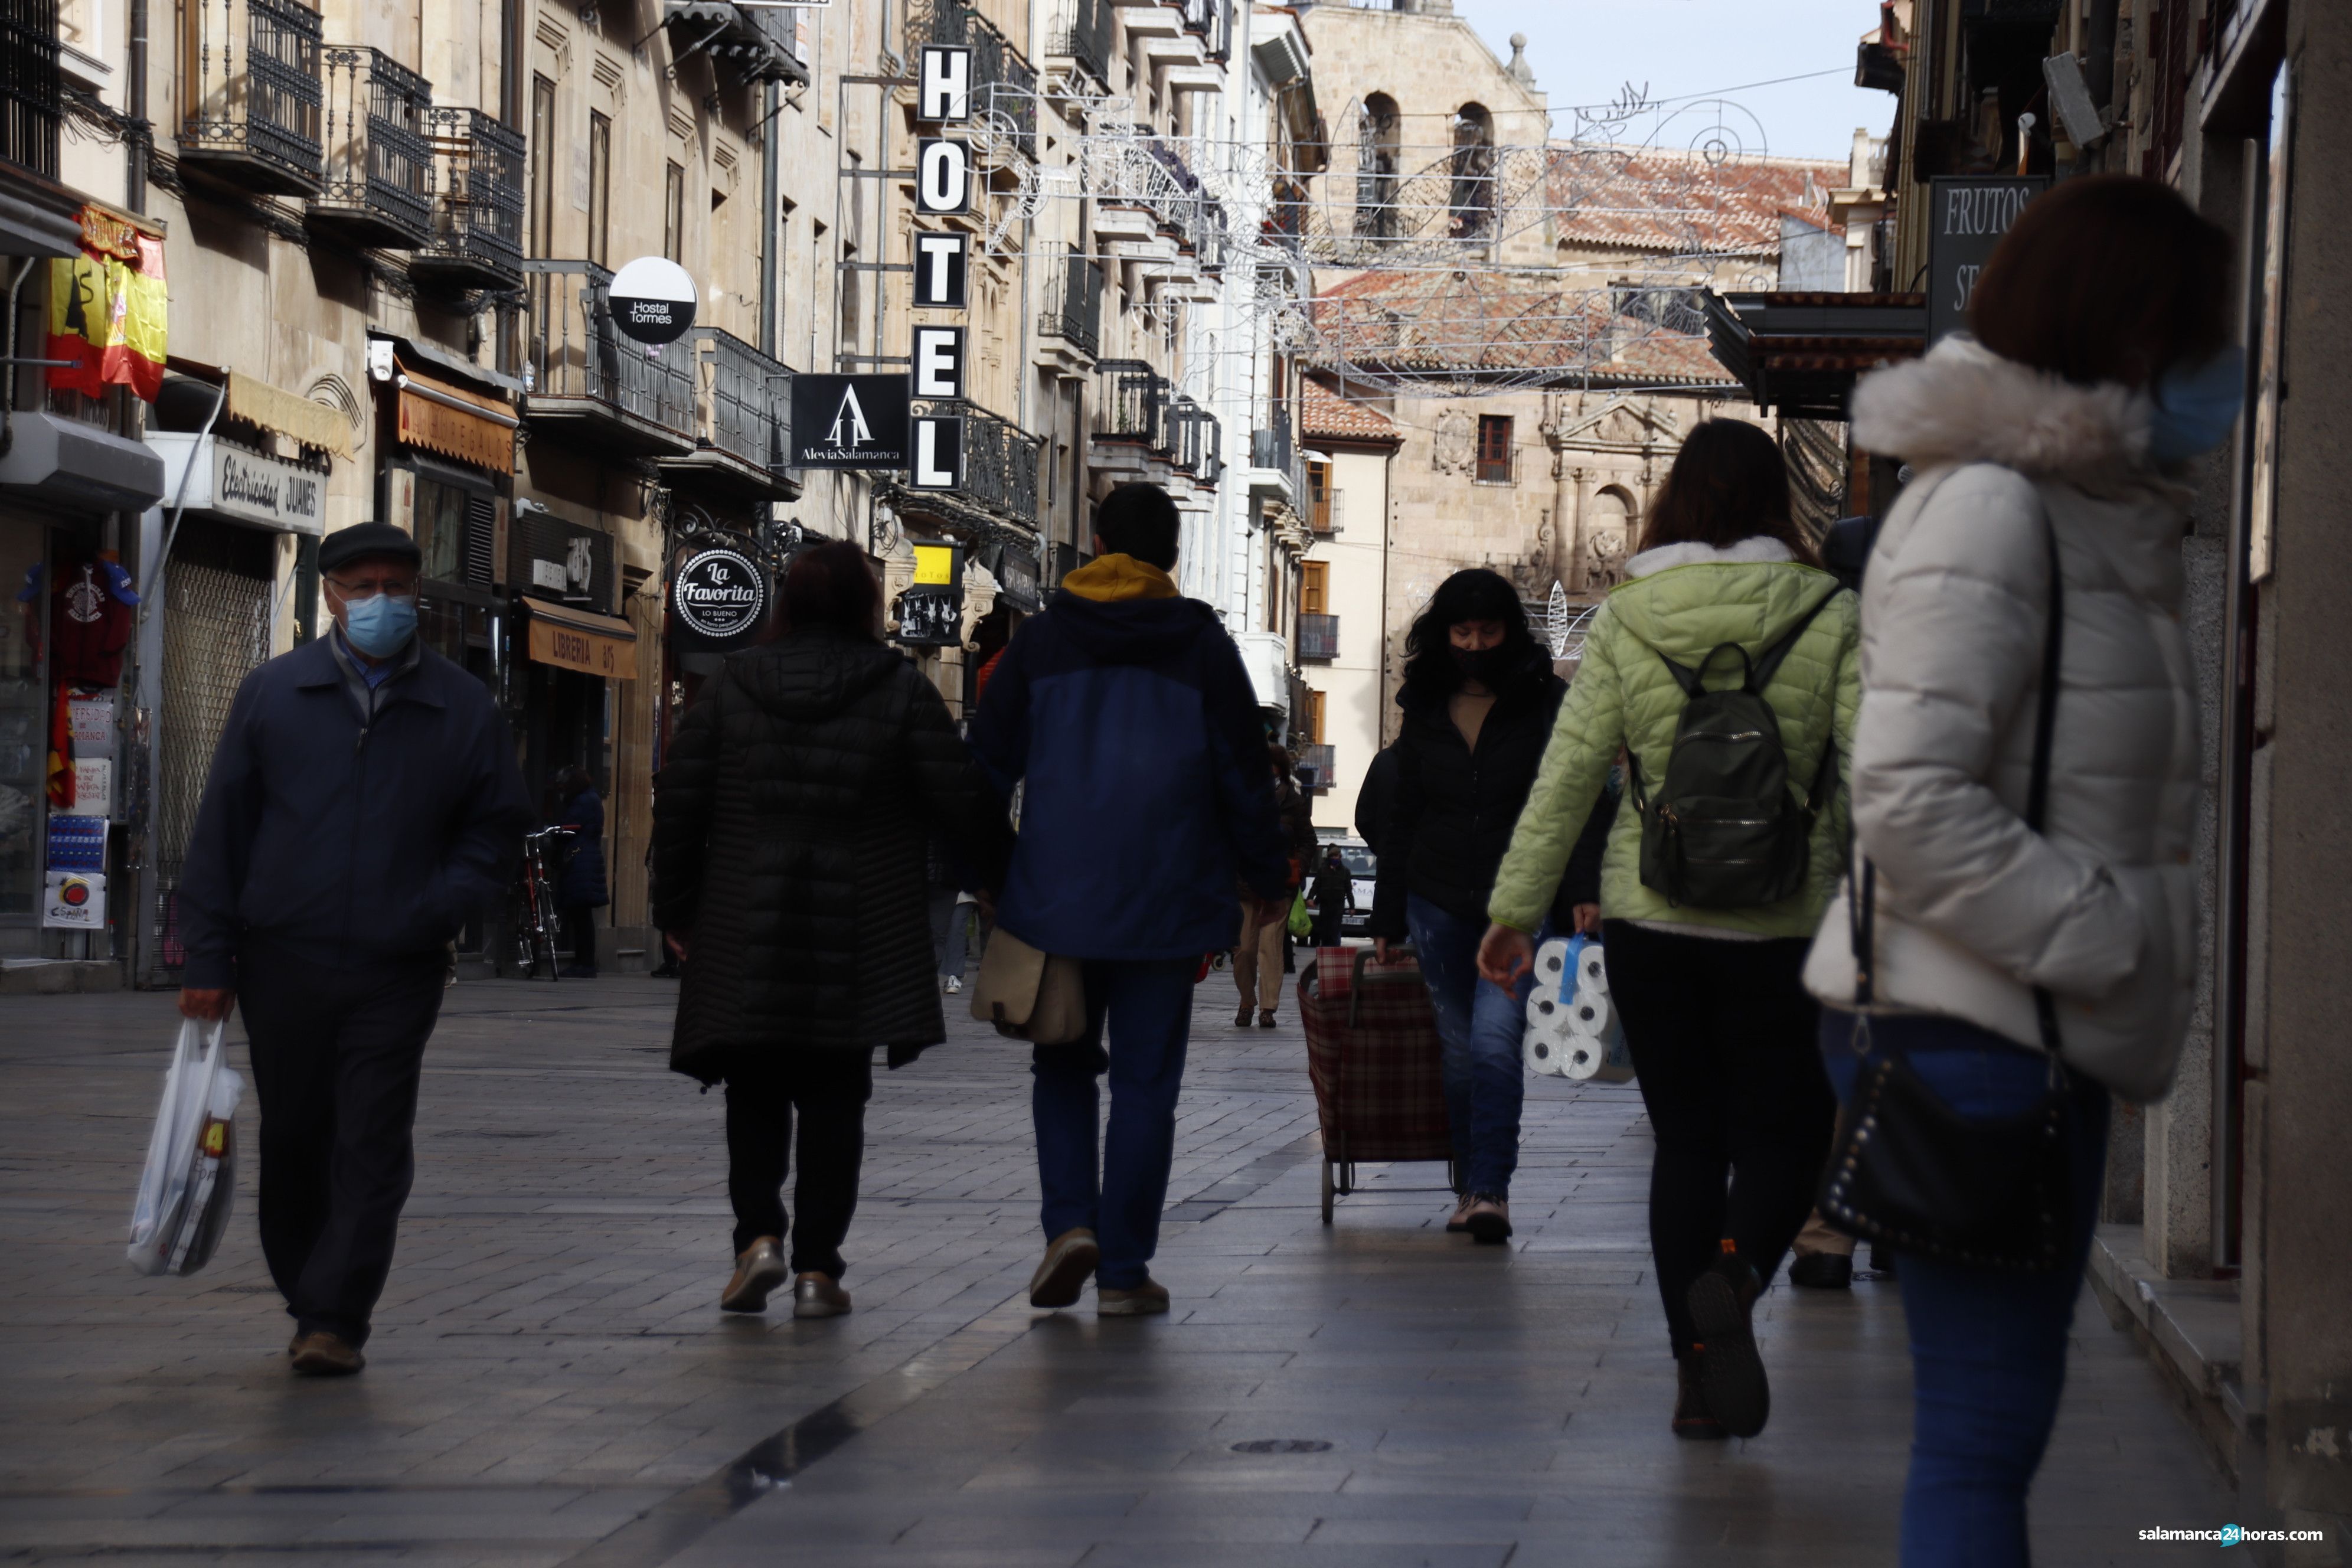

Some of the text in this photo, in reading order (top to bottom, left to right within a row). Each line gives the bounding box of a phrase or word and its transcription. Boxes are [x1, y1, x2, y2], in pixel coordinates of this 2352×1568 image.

[1943, 187, 2030, 235] FRUTOS
[917, 51, 968, 486] HOTEL
[1954, 264, 1980, 311] SE
[630, 311, 672, 324] Tormes
[633, 302, 669, 314] Hostal
[222, 454, 316, 517] Electricidad JUANES
[707, 563, 731, 586] La
[684, 583, 756, 601] Favorita
[553, 631, 591, 665] LIBRERIA
[74, 731, 105, 740] AMANCA
